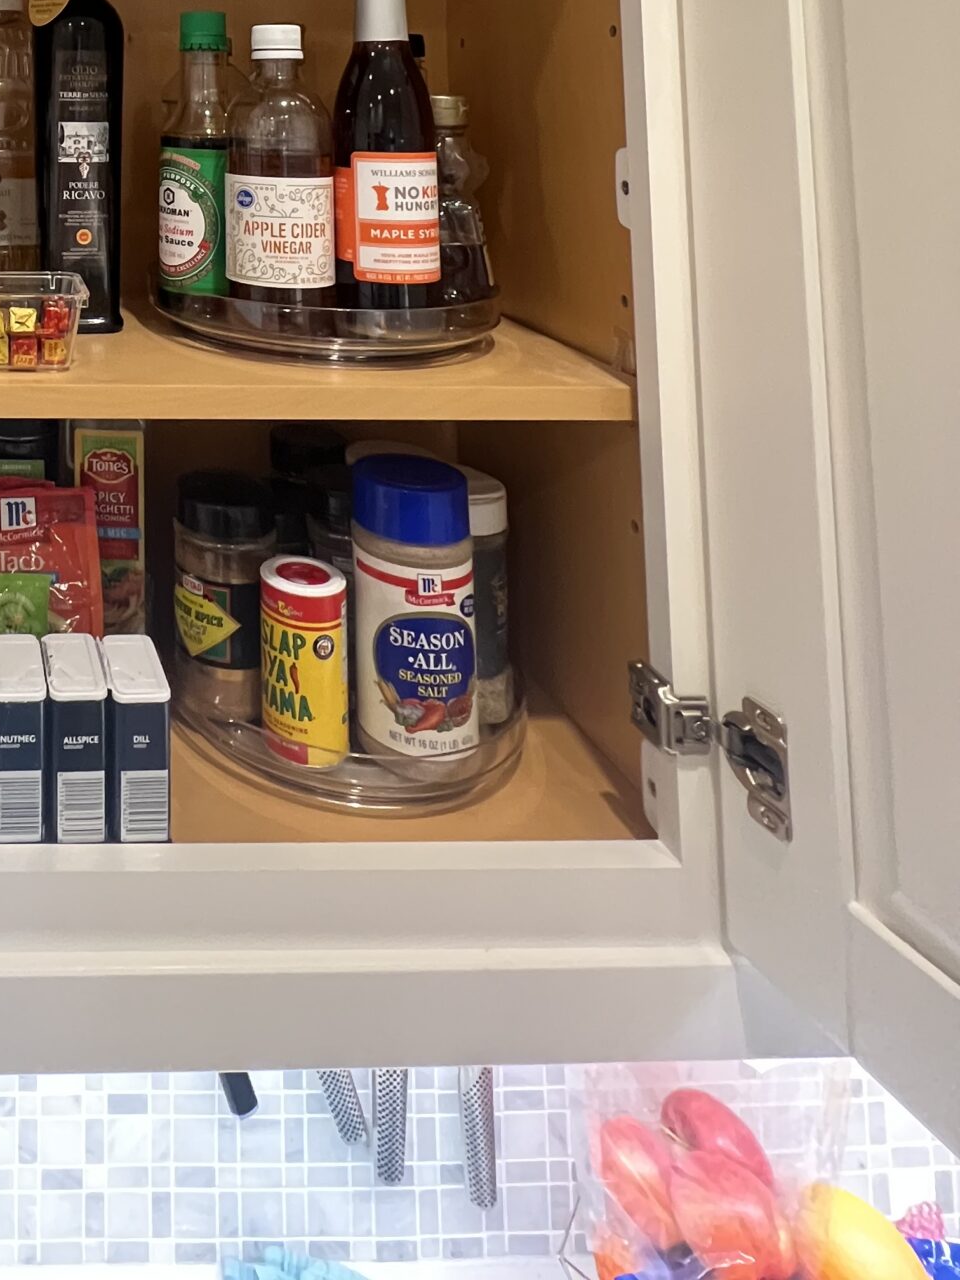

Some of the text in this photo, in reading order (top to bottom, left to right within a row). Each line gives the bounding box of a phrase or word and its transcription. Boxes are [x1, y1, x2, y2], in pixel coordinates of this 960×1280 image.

[371, 169, 417, 177] WILLIAMS
[68, 182, 98, 190] PODERE
[163, 172, 196, 191] PURPOSE
[62, 190, 106, 200] RICAVO
[394, 186, 420, 200] NO
[164, 223, 194, 237] Sodium
[243, 220, 326, 238] APPLE CIDER
[370, 228, 415, 239] MAPLE
[164, 235, 194, 247] Sauce
[261, 239, 312, 254] VINEGAR
[177, 249, 206, 272] EXCELLENCE
[89, 457, 129, 474] Tone's
[408, 593, 451, 605] McCormick
[262, 616, 306, 660] SLAP
[390, 626, 465, 650] SEASON
[269, 653, 289, 687] YA
[398, 669, 462, 684] SEASONED
[417, 686, 448, 698] SALT
[0, 735, 36, 744] NUTMEG
[63, 736, 99, 745] ALLSPICE
[133, 735, 151, 743] DILL
[389, 729, 402, 743] NET
[404, 735, 416, 747] WT
[418, 738, 427, 749] 16
[428, 740, 439, 751] OZ
